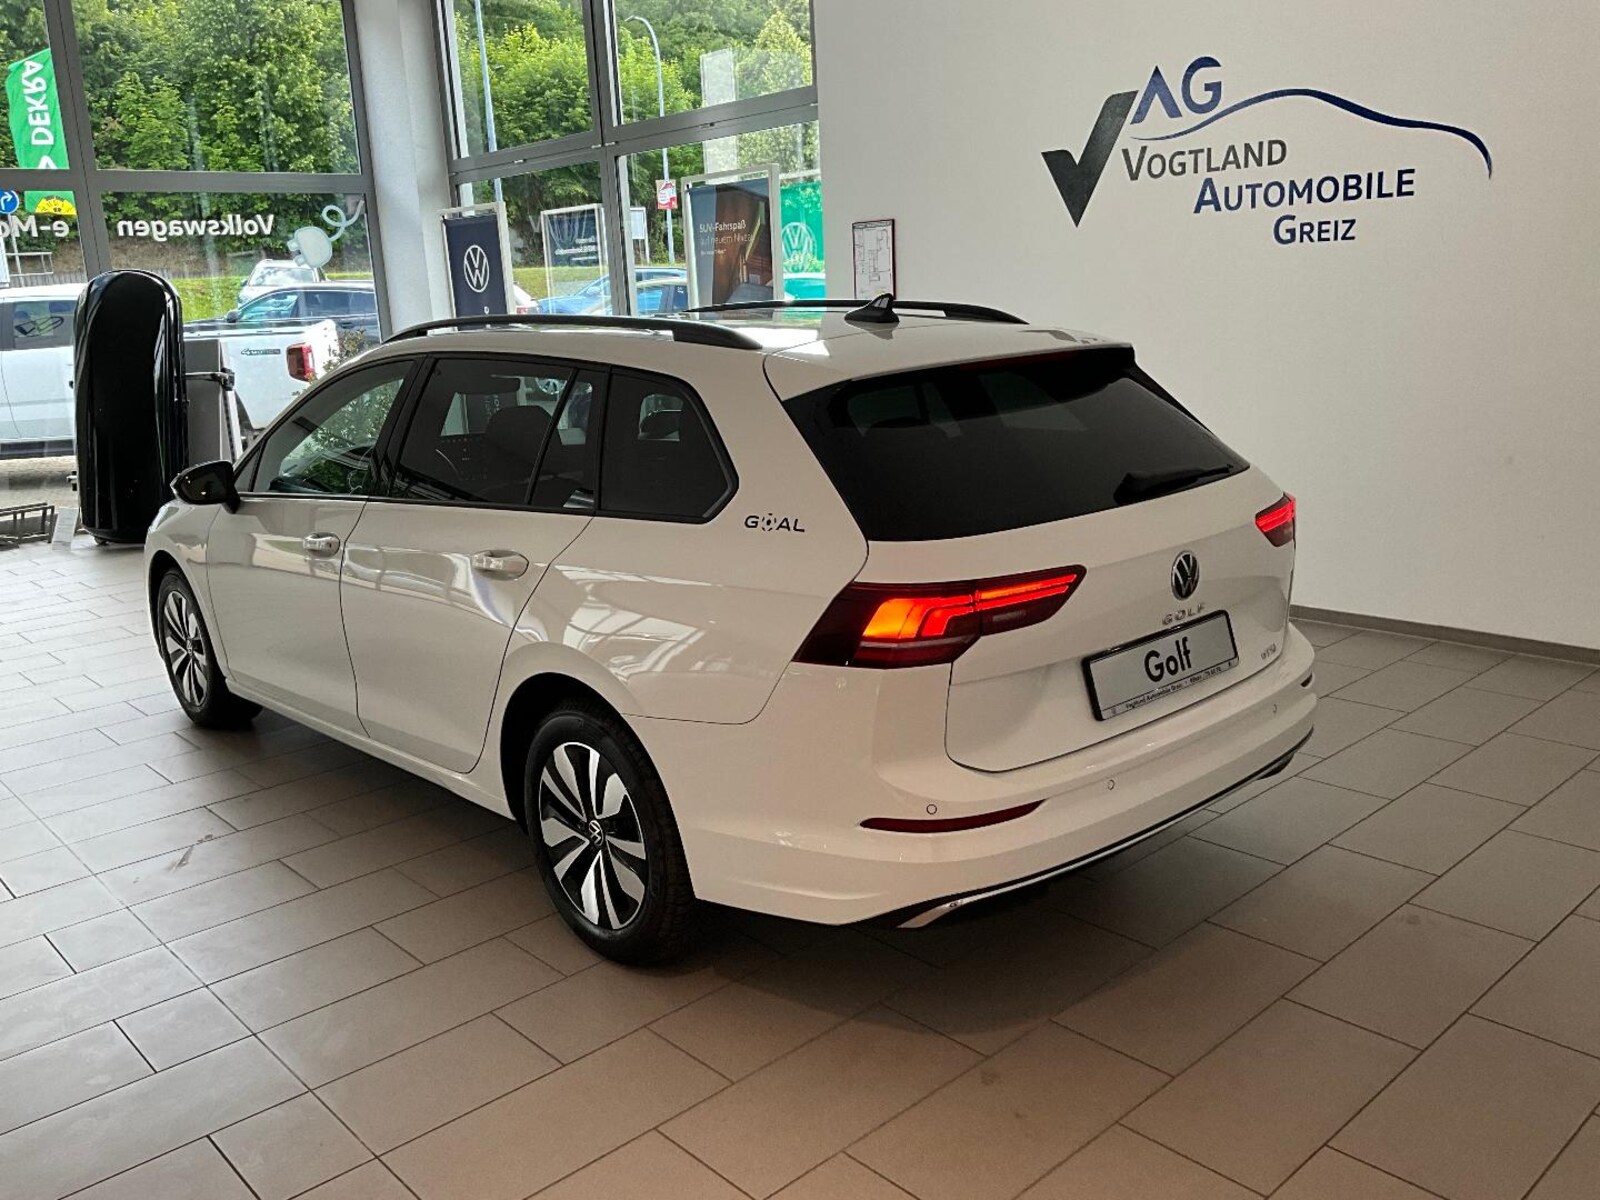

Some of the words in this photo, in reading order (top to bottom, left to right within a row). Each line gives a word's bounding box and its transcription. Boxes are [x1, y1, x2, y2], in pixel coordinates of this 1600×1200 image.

[1122, 139, 1287, 181] VOGTLAND
[1194, 169, 1416, 214] AUTOMOBILE
[1273, 214, 1356, 245] GREIZ
[1162, 602, 1206, 625] GOLF
[1144, 636, 1191, 682] Golf
